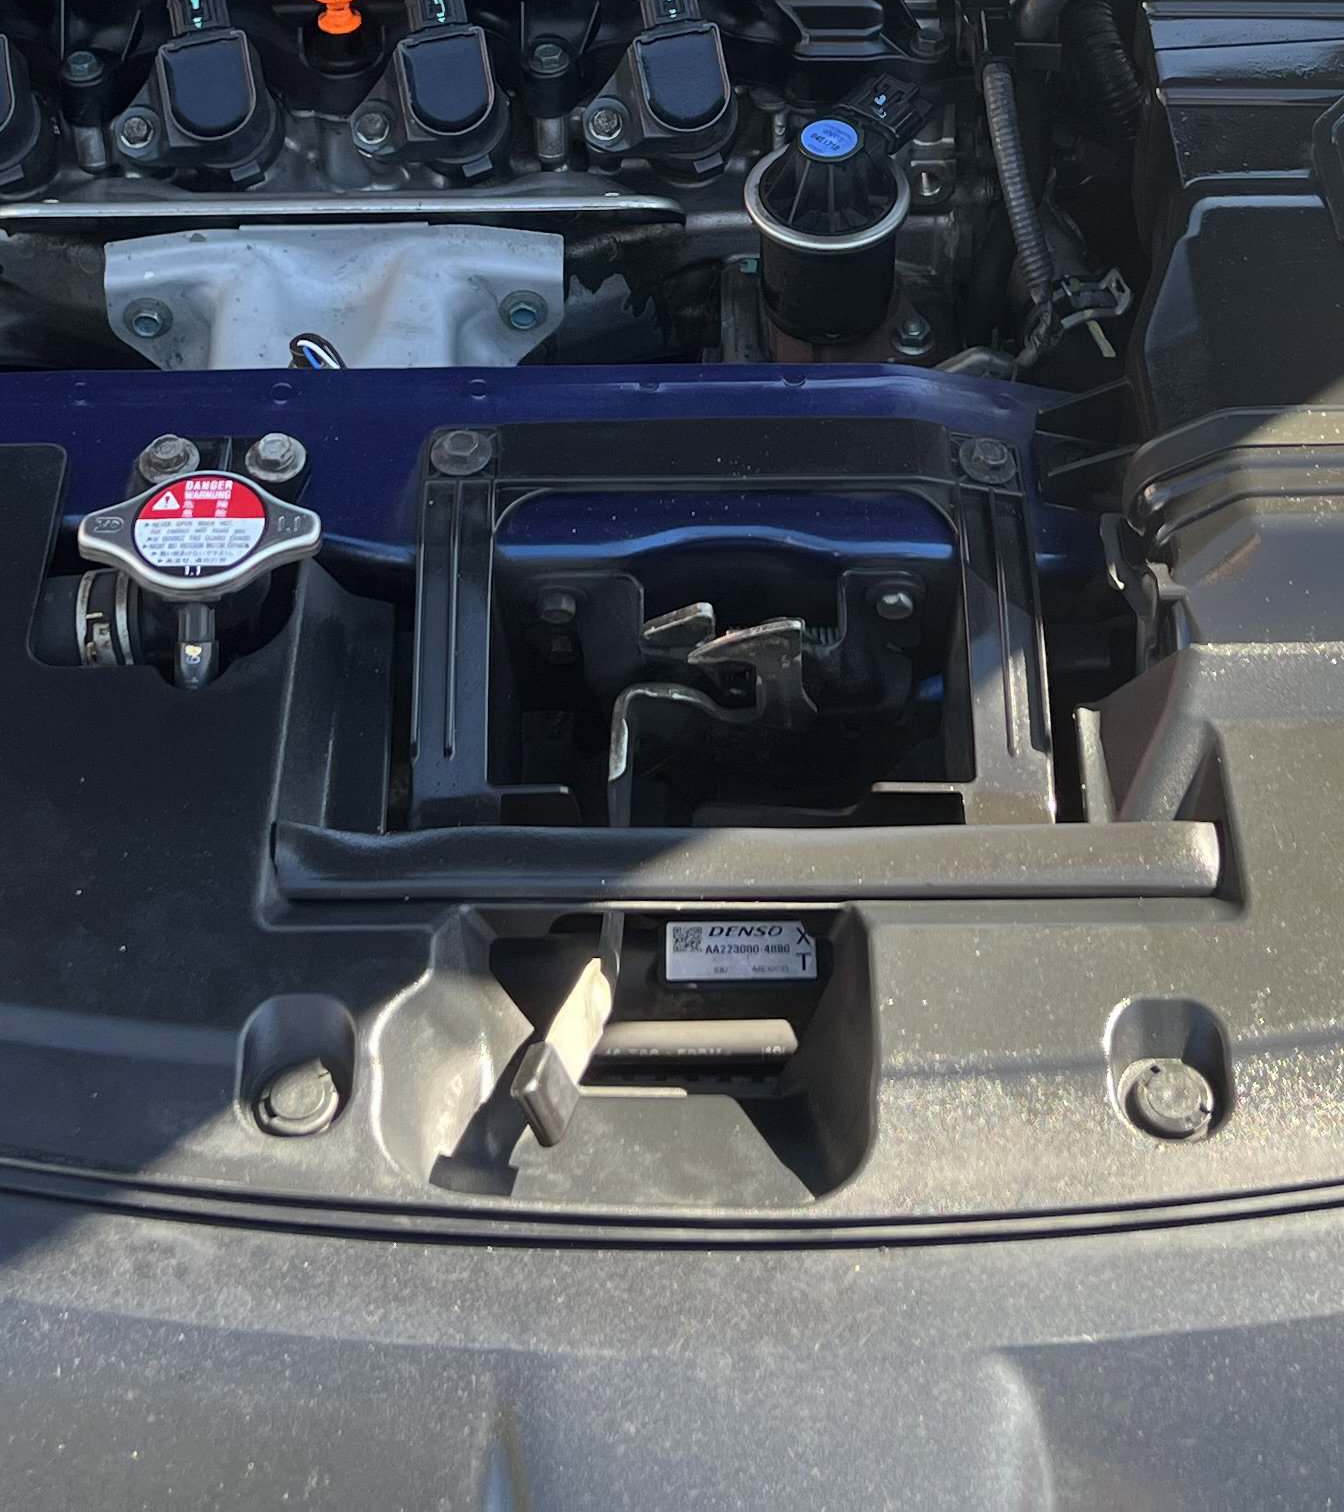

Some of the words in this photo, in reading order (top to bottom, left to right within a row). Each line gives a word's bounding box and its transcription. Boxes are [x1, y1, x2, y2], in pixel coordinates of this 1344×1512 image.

[185, 480, 233, 490] DANGER
[708, 925, 783, 937] DENSO
[796, 927, 811, 945] X
[795, 952, 812, 971] T
